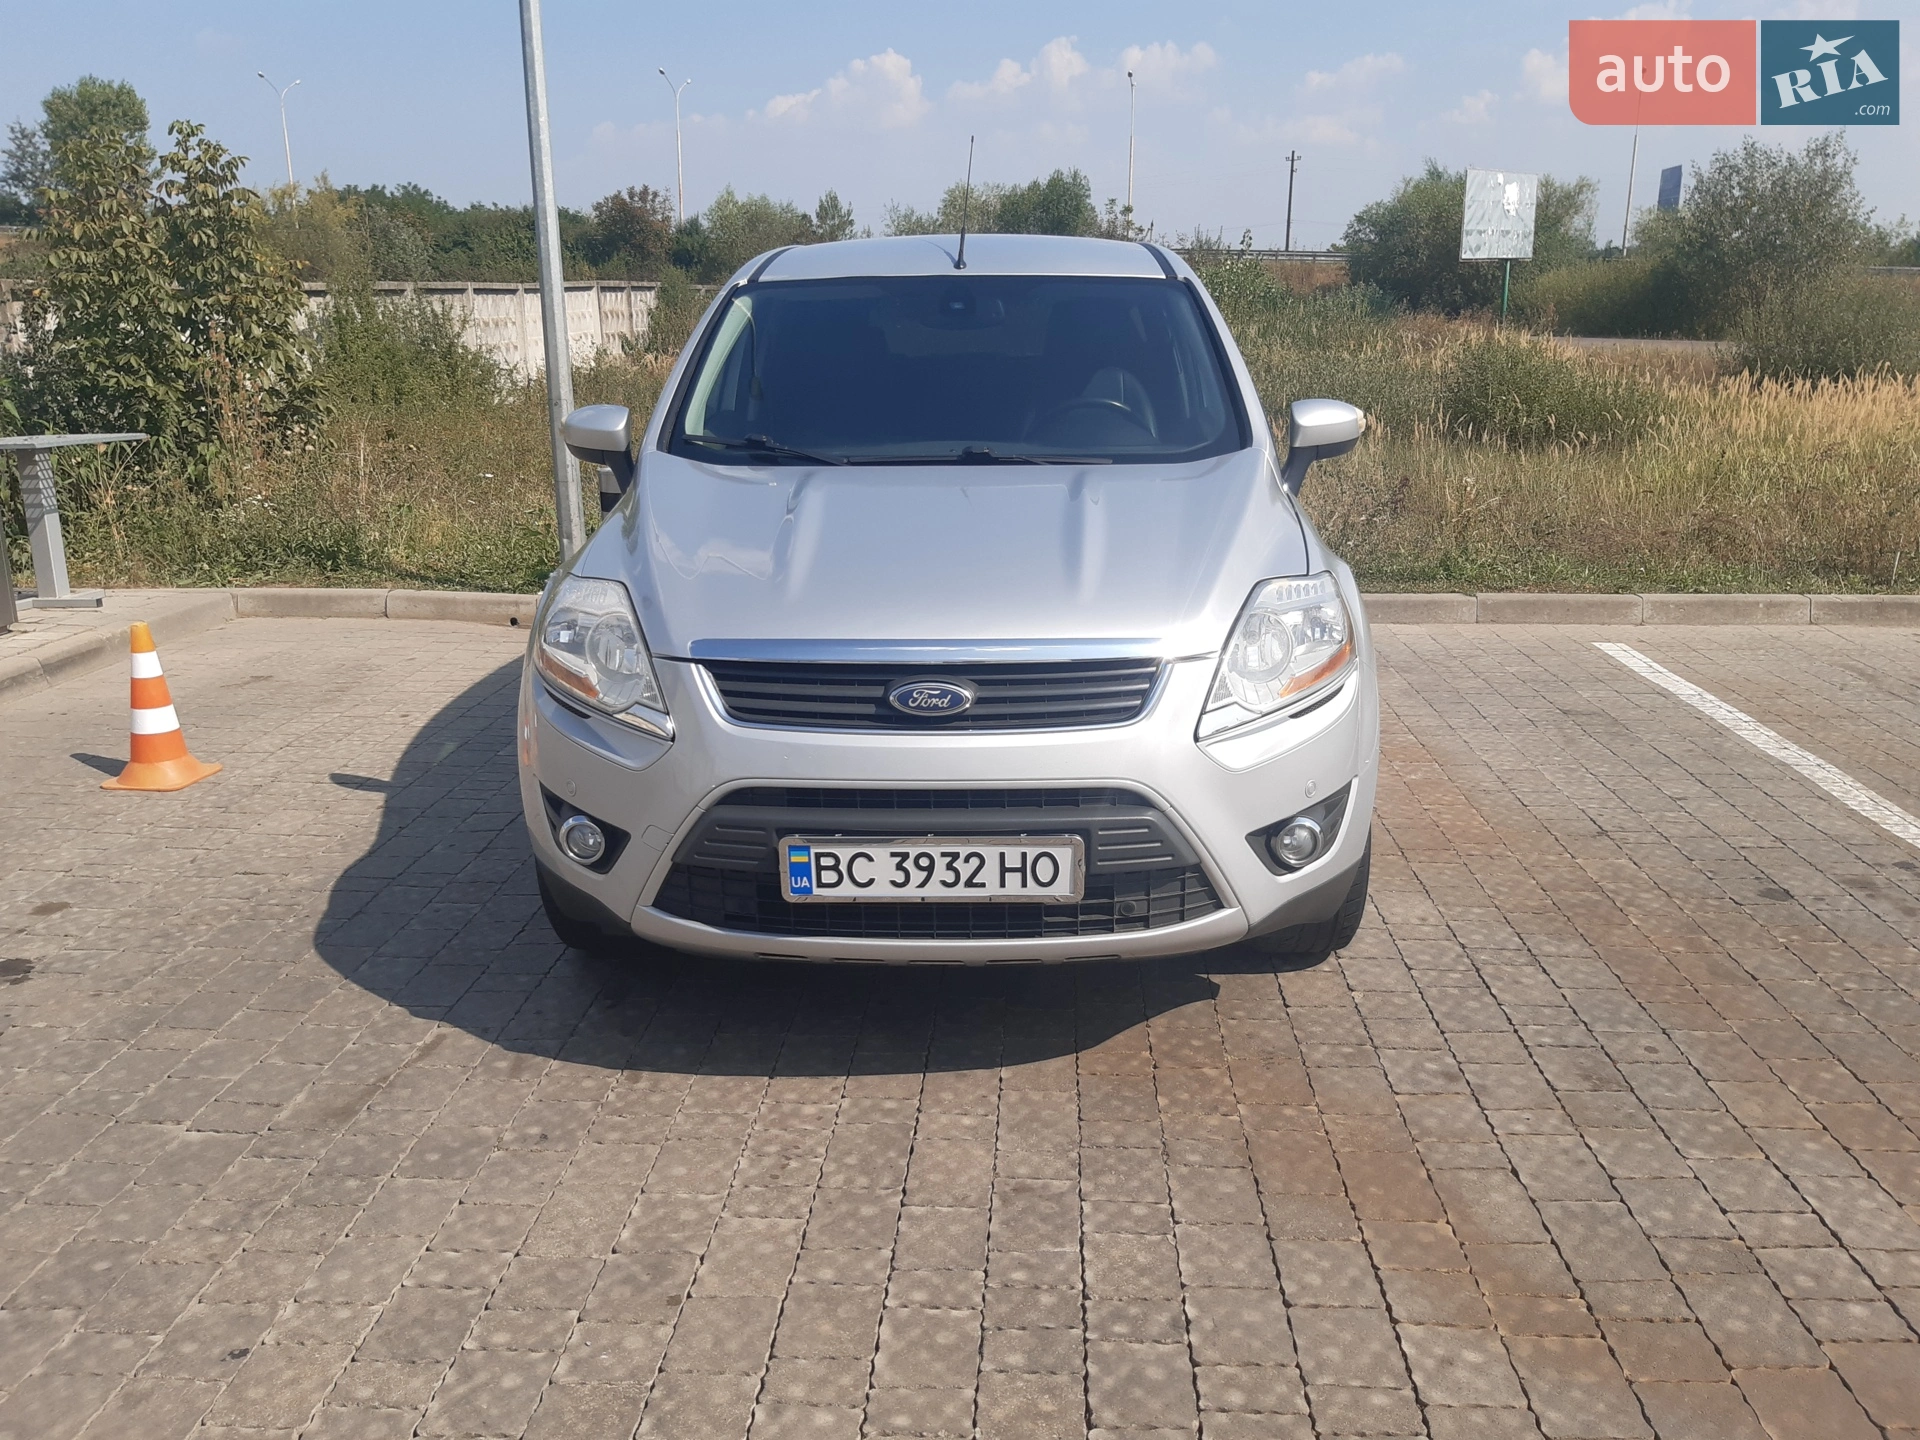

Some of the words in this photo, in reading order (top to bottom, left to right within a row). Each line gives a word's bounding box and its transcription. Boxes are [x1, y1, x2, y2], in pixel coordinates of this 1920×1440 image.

[908, 689, 952, 708] Ford
[814, 851, 876, 889] BC
[889, 851, 987, 888] 3932
[999, 851, 1060, 888] HO
[791, 876, 811, 888] UA
